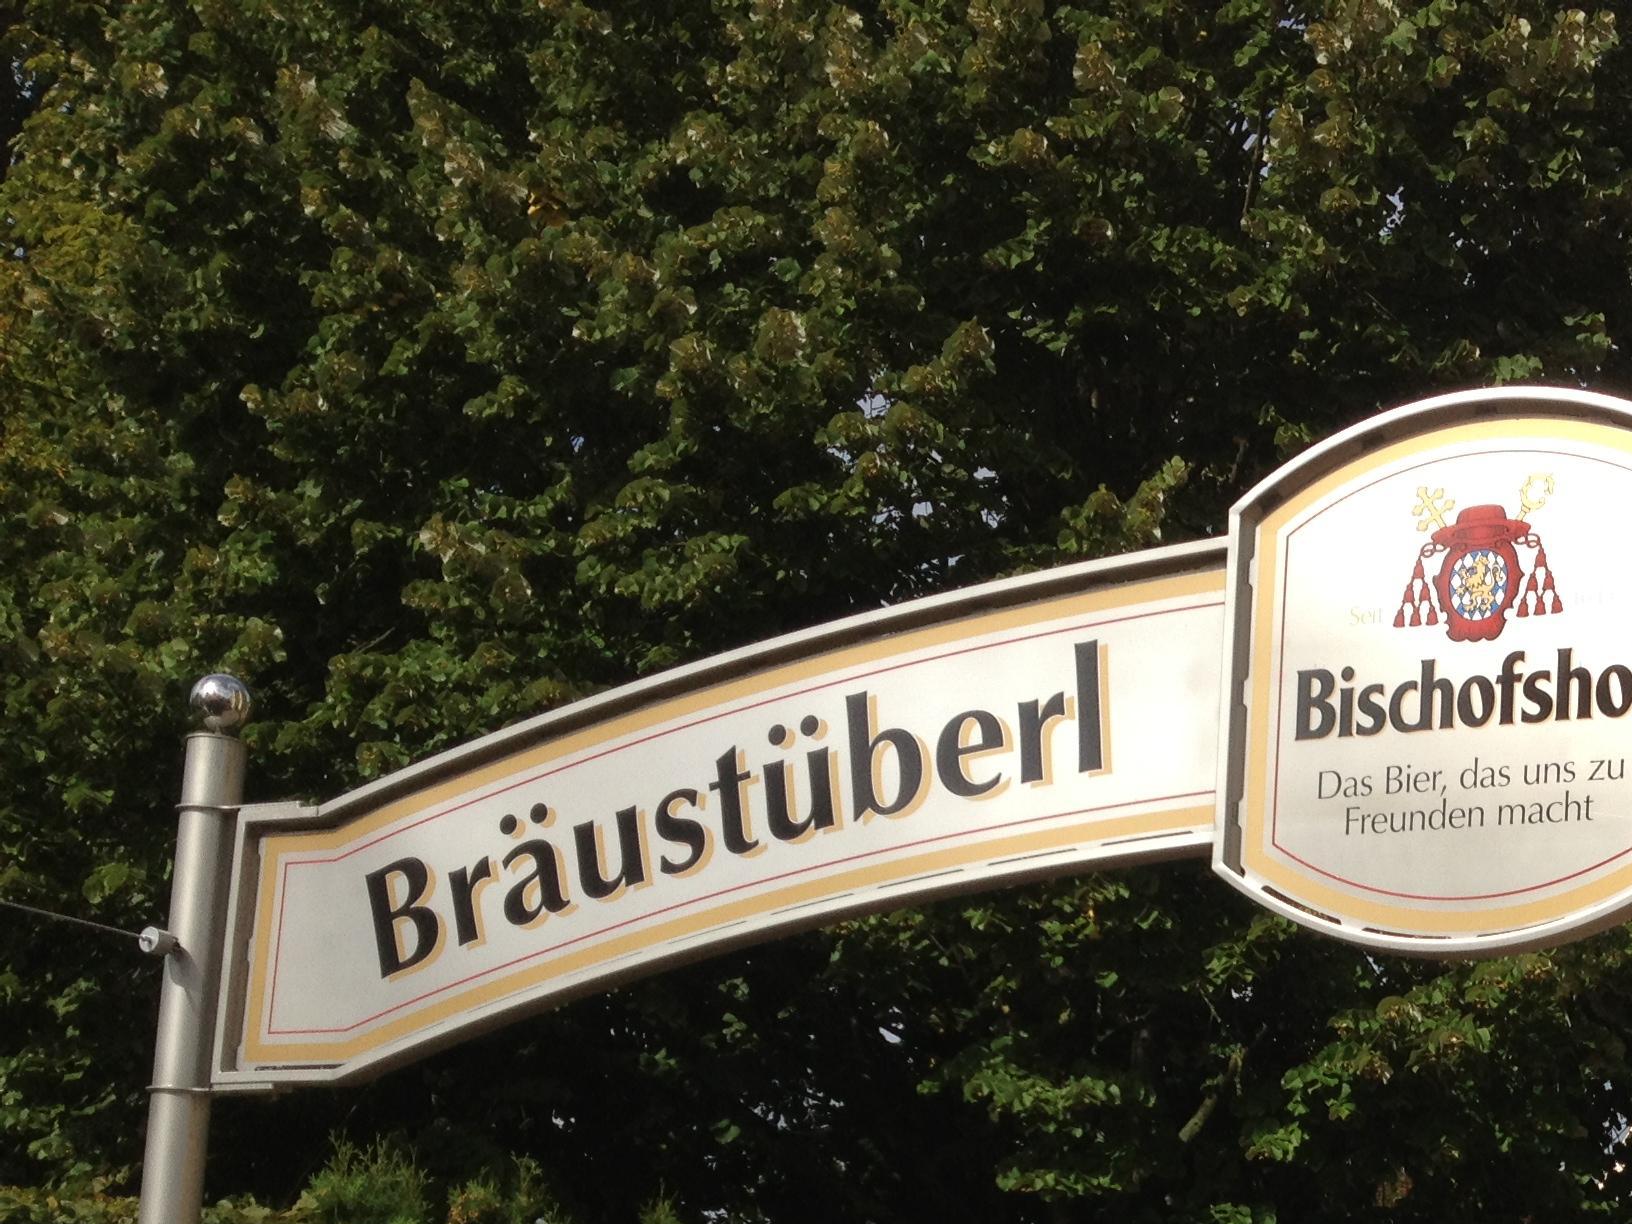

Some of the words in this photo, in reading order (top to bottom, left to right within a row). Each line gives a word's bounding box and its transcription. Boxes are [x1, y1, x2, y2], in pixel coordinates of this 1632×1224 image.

[1317, 769, 1373, 800] Das
[1385, 764, 1448, 797] Bier,
[1459, 757, 1511, 791] das
[1523, 761, 1577, 786] uns
[1587, 757, 1626, 782] zu
[365, 638, 1112, 980] Bräustüberl
[1344, 798, 1486, 836] Freunden
[1496, 789, 1595, 826] macht
